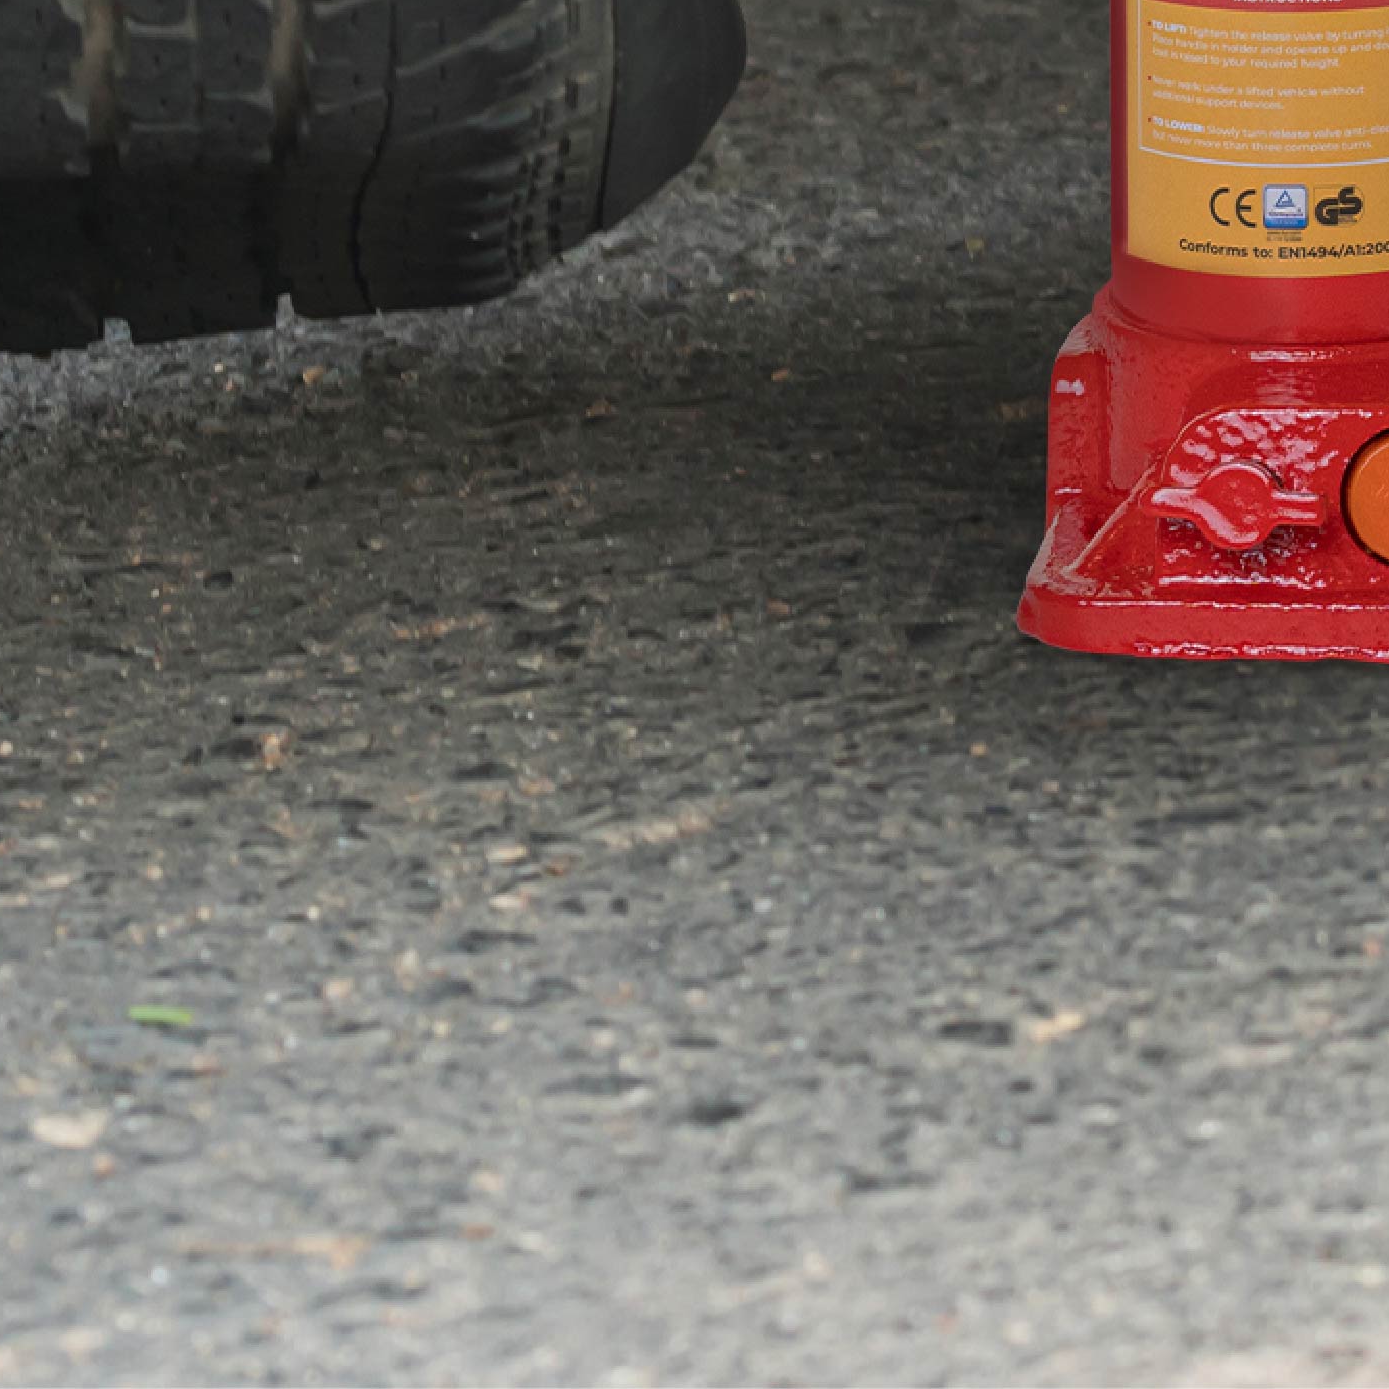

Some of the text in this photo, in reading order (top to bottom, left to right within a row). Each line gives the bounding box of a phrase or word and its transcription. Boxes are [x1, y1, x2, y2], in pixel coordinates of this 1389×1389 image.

[1209, 186, 1257, 228] CE
[1178, 238, 1249, 258] Conforms
[1252, 246, 1274, 259] to:
